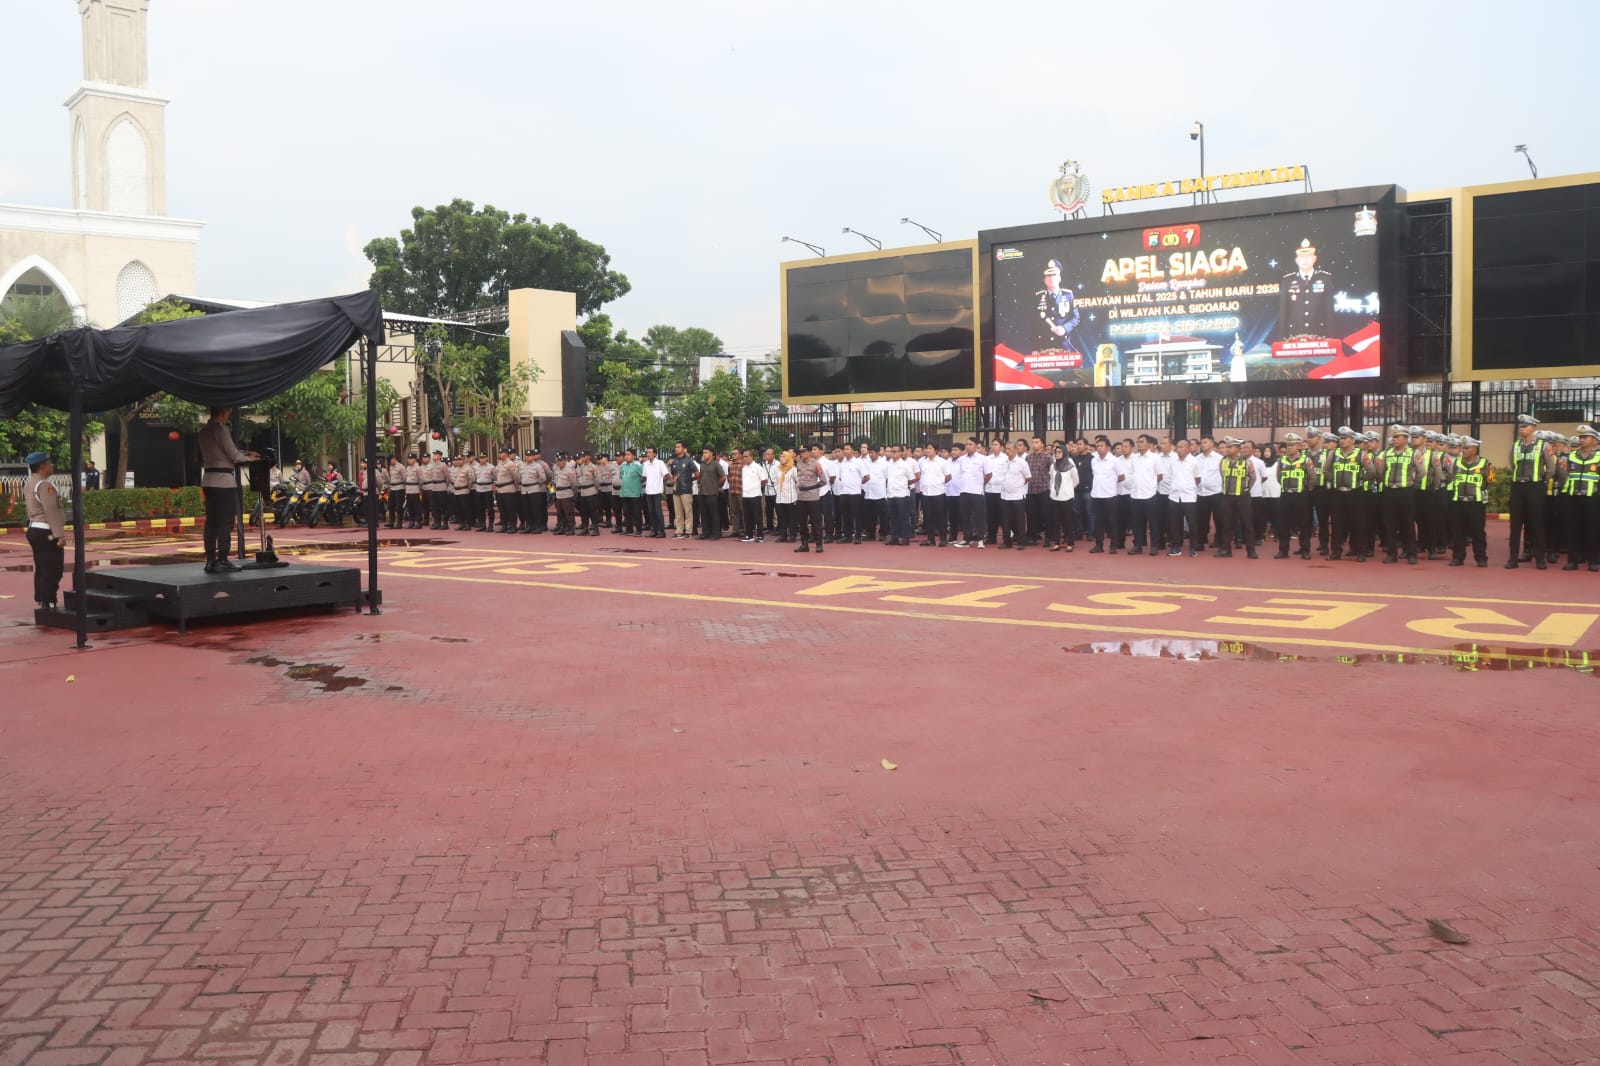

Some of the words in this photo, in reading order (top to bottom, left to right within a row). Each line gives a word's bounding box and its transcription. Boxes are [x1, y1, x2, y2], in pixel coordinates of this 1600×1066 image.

[1101, 181, 1176, 204] SANIKA
[1179, 165, 1305, 194] SATYAWADA
[1101, 254, 1165, 284] APEL
[1168, 247, 1248, 279] SIAGA
[1073, 295, 1122, 309] PERAYAAN
[1123, 293, 1153, 305] NATAL
[1156, 291, 1177, 302] 2025
[1179, 291, 1187, 301] &
[1189, 287, 1223, 299] TAHUN
[1225, 286, 1254, 297] BARU
[1256, 284, 1280, 295] 2026
[1138, 281, 1169, 293] Dalam
[1108, 310, 1118, 320] DI
[1120, 306, 1162, 318] WILAYAH
[1163, 304, 1186, 315] KAB.
[1188, 301, 1240, 313] SIDOARJO
